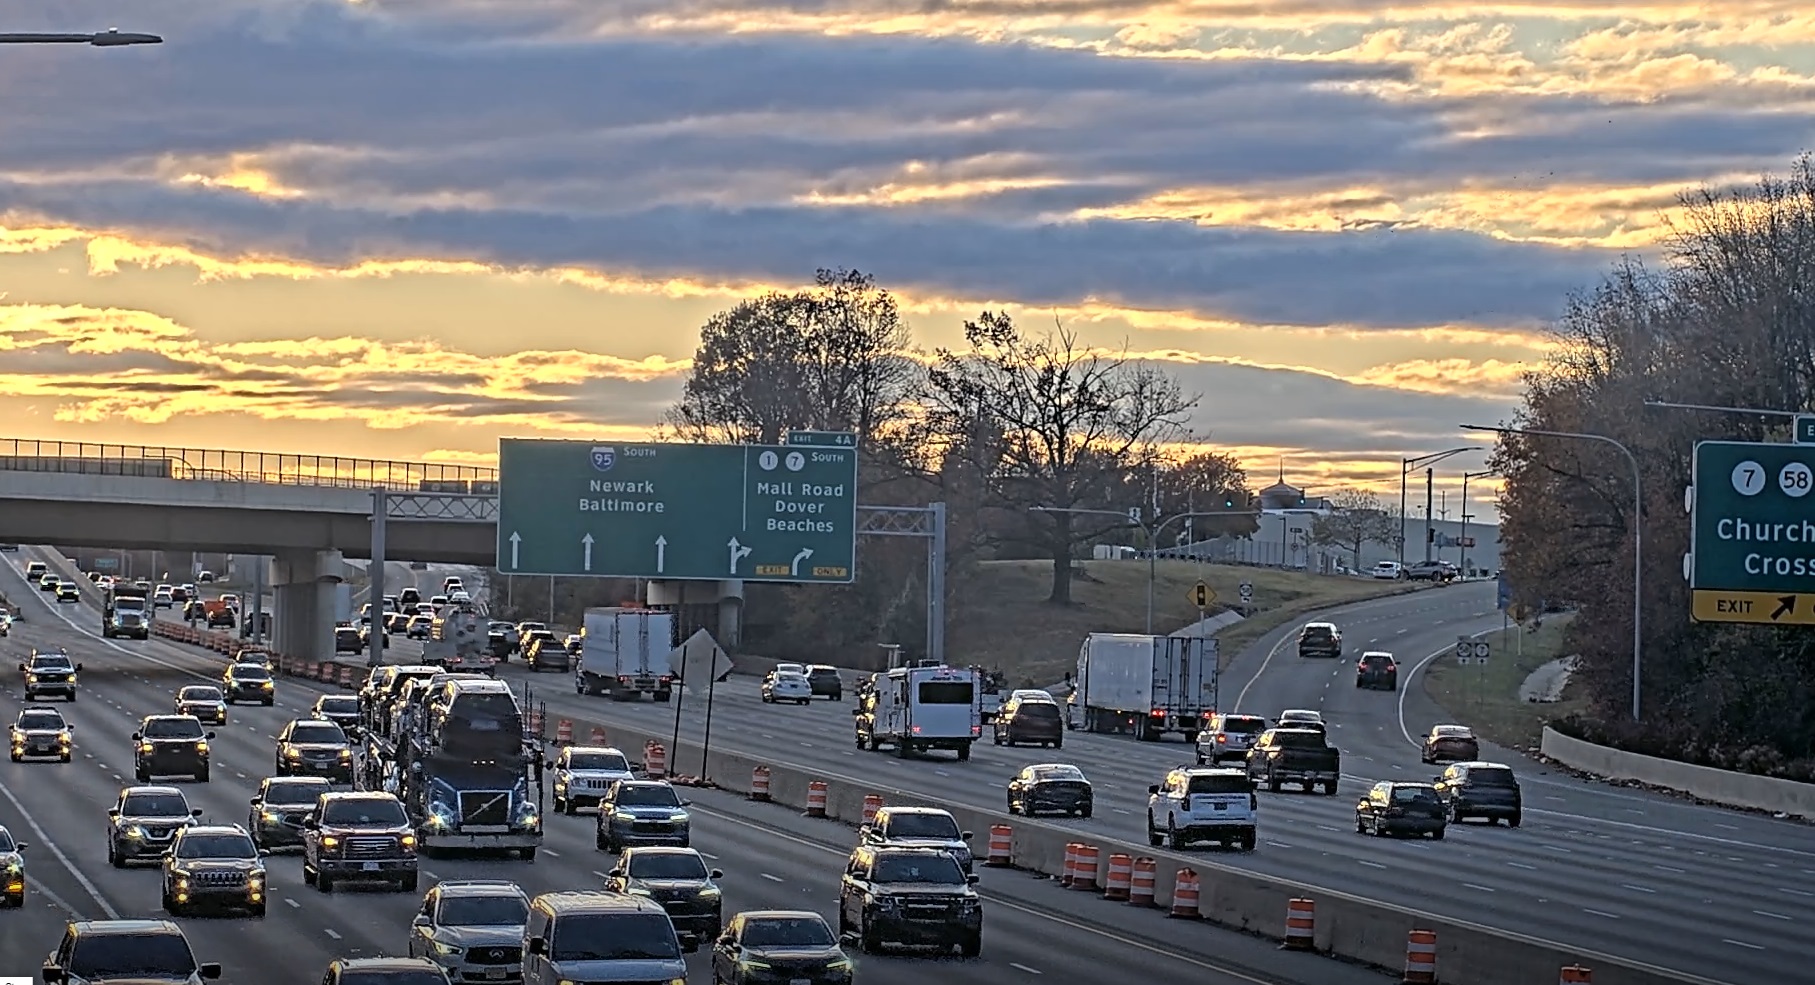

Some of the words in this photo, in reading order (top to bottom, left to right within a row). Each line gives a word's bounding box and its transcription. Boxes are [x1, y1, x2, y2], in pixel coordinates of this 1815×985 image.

[835, 435, 851, 445] 4A
[594, 453, 612, 466] 95
[623, 446, 657, 457] SOUTH
[791, 456, 799, 467] 7
[811, 451, 844, 463] SOUTH
[1743, 469, 1755, 488] 7
[1783, 471, 1809, 489] 58
[590, 480, 654, 494] Newark
[757, 482, 793, 496] Mall
[802, 483, 844, 497] Road
[579, 498, 664, 513] Baltimore
[775, 500, 825, 513] Dover
[767, 518, 834, 532] Beaches
[1717, 518, 1815, 542] Church
[1717, 600, 1753, 614] EXIT
